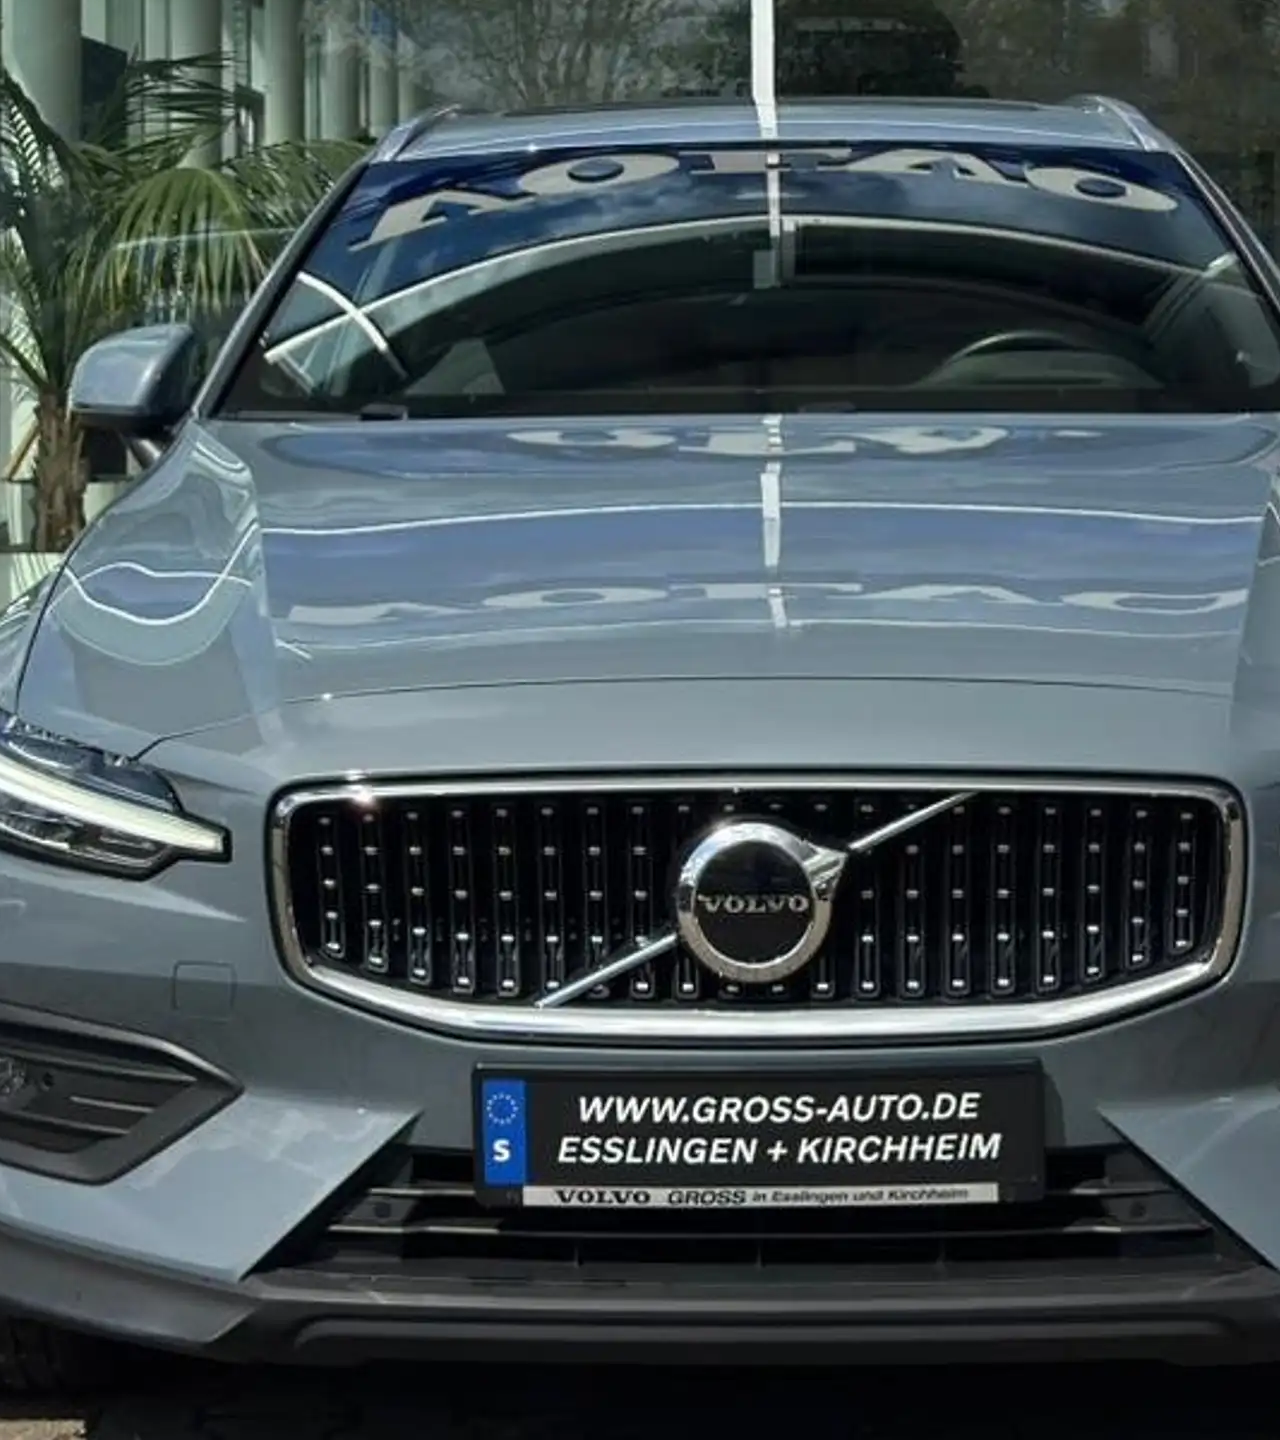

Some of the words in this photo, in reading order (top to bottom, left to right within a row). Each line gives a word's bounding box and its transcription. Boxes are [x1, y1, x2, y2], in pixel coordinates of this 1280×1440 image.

[697, 893, 809, 914] VOLVO
[578, 1092, 982, 1124] WWW.GROSS-AUTO.DE
[492, 1139, 511, 1162] S
[557, 1135, 759, 1164] ESSLINGEN
[766, 1140, 788, 1162] +
[797, 1132, 1002, 1164] KIRCHHEIM
[555, 1189, 651, 1205] VOLVO
[668, 1189, 747, 1206] GROSS
[752, 1190, 767, 1203] in
[771, 1189, 849, 1205] Esslingen
[852, 1189, 883, 1202] und
[887, 1187, 969, 1202] Kirchheim
